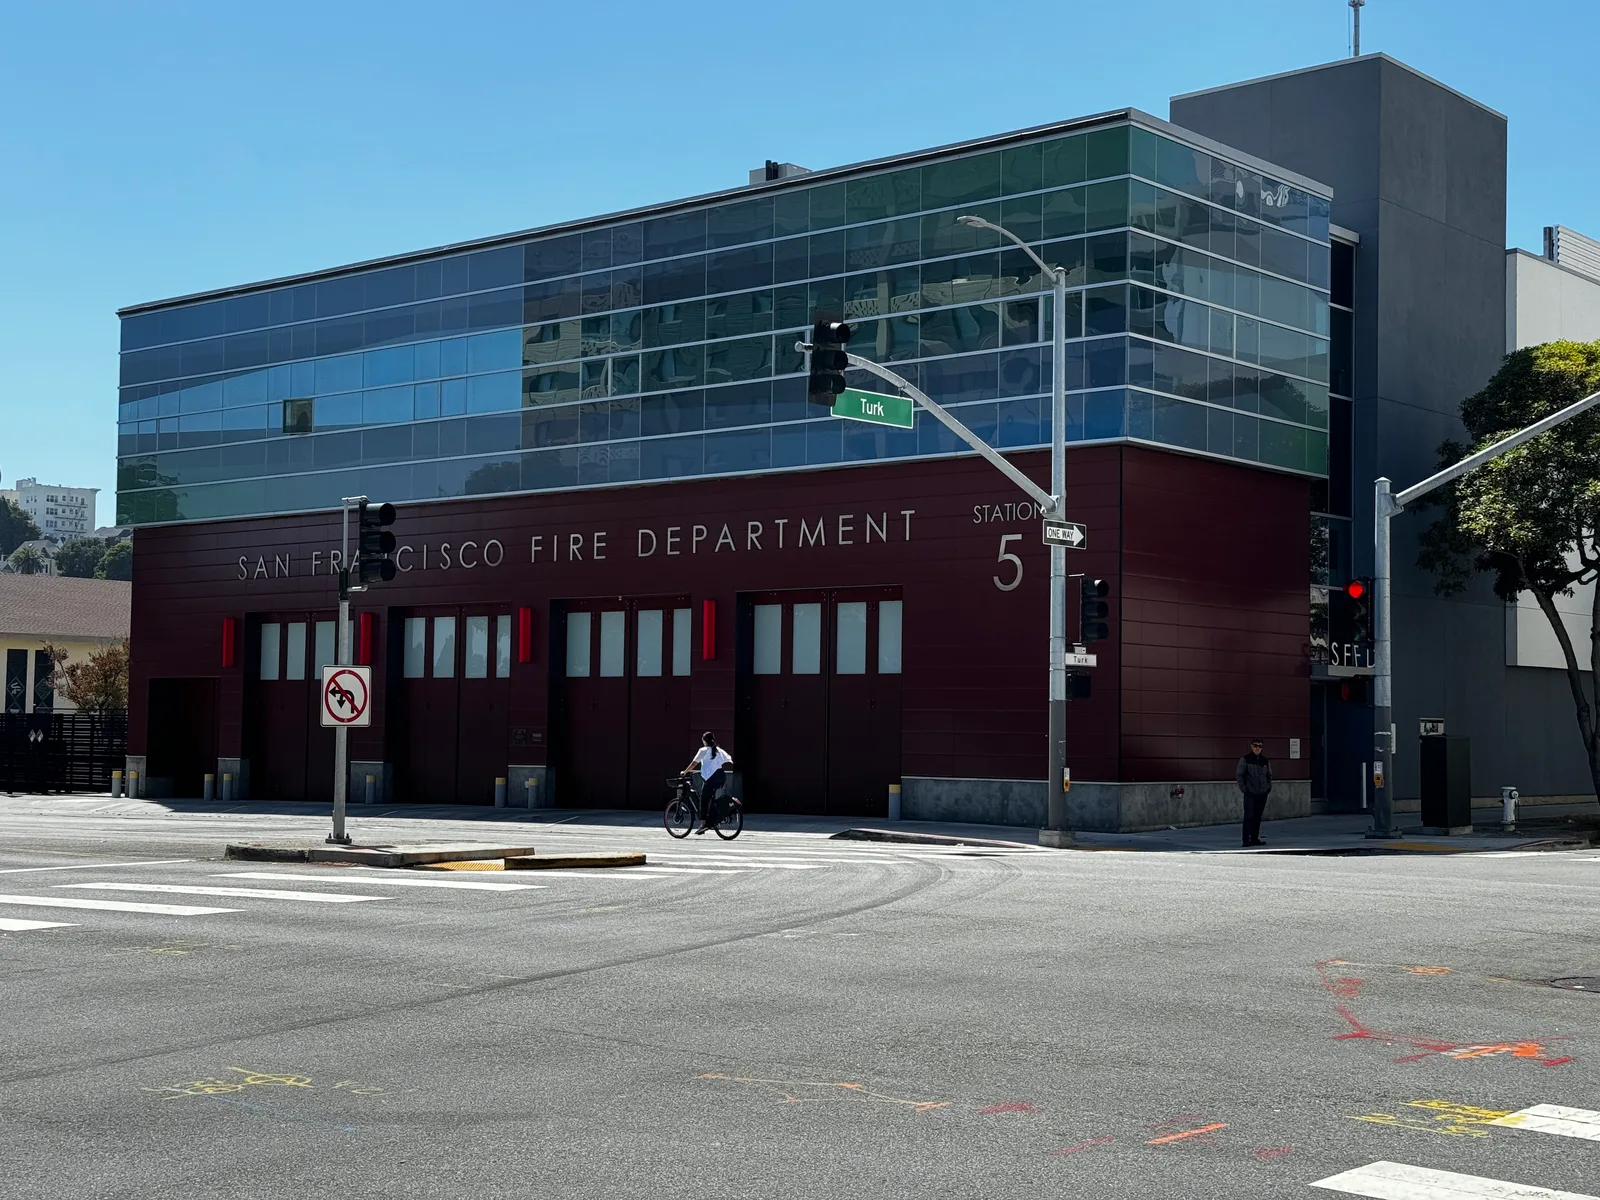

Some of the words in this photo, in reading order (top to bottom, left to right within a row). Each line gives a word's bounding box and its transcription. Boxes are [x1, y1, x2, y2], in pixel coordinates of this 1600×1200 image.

[860, 398, 884, 417] Turk
[1048, 527, 1061, 539] ONE
[1062, 530, 1074, 540] WAY
[238, 553, 290, 581] SAN
[312, 539, 504, 576] FRACISCO
[531, 532, 607, 563] FIRE
[637, 510, 916, 558] DEPARTMENT
[993, 533, 1024, 592] 5
[1073, 655, 1088, 664] Turk
